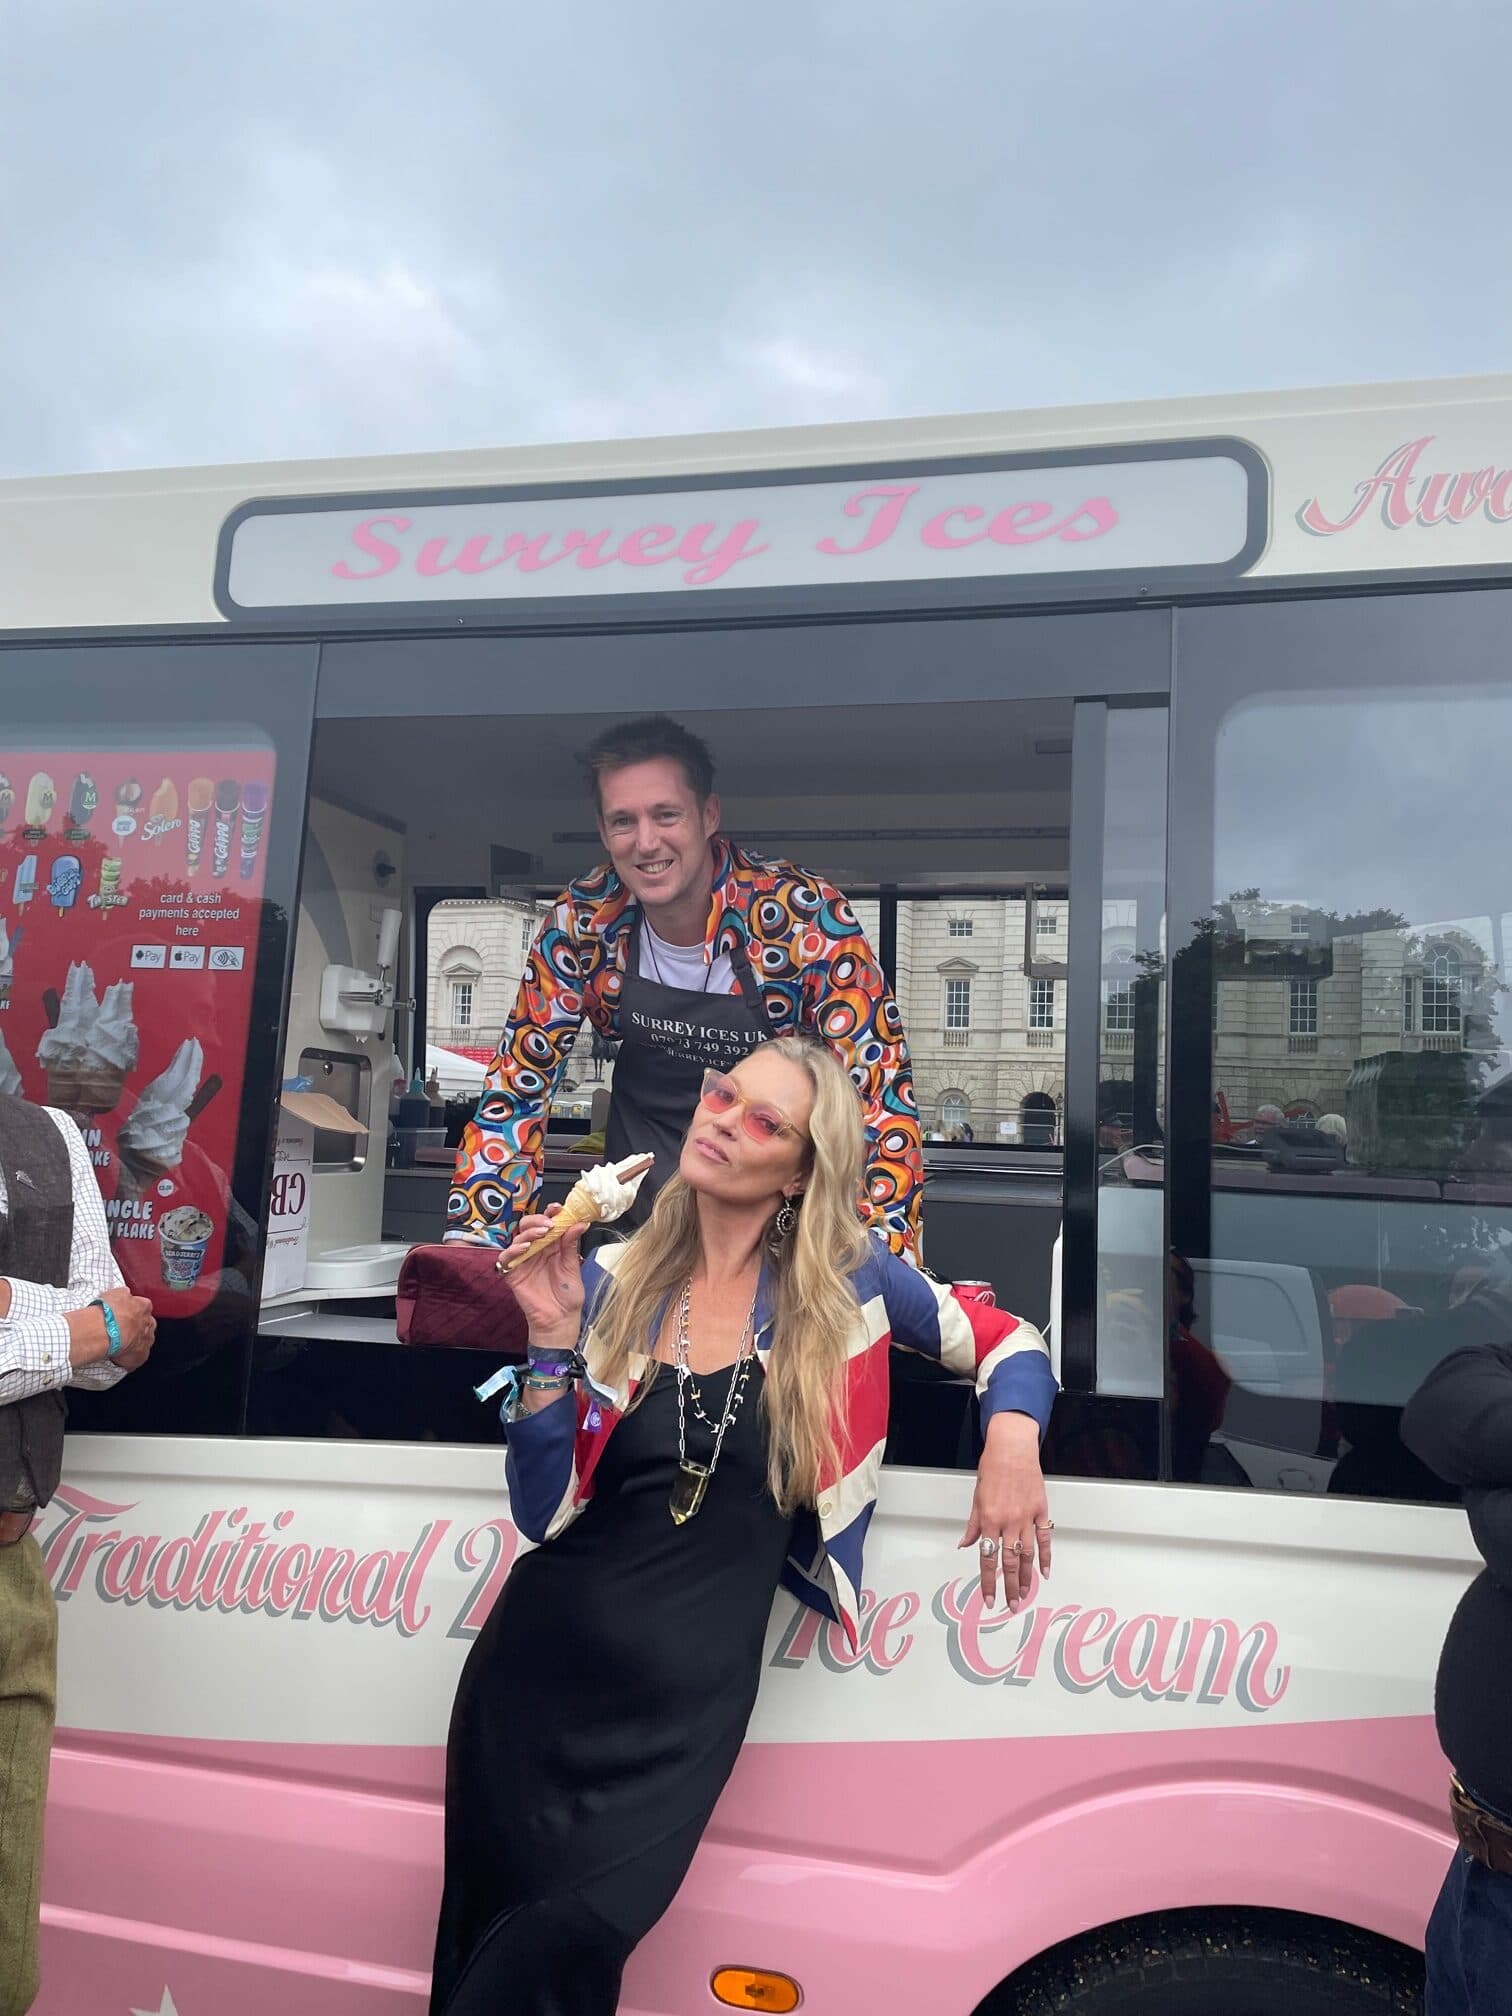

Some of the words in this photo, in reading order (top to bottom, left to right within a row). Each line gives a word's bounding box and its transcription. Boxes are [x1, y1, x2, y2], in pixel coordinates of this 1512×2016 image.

[331, 515, 771, 586] Surrey
[814, 483, 1121, 557] Ices
[141, 818, 182, 841] Solero
[160, 892, 183, 904] card
[185, 892, 194, 904] &
[196, 892, 222, 904] cash
[139, 907, 190, 921] payments
[192, 907, 240, 921] accepted
[175, 924, 199, 936] here
[144, 950, 162, 963] Pay
[183, 951, 201, 964] Pay
[631, 1011, 696, 1037] SURREY
[699, 1026, 739, 1043] ICES
[694, 1041, 719, 1054] 749
[723, 1045, 749, 1057] 392
[104, 1200, 153, 1220] NGLE
[117, 1221, 155, 1240] FLAKE
[32, 1484, 440, 1638] Traditional
[931, 1567, 1292, 1714] Cream
